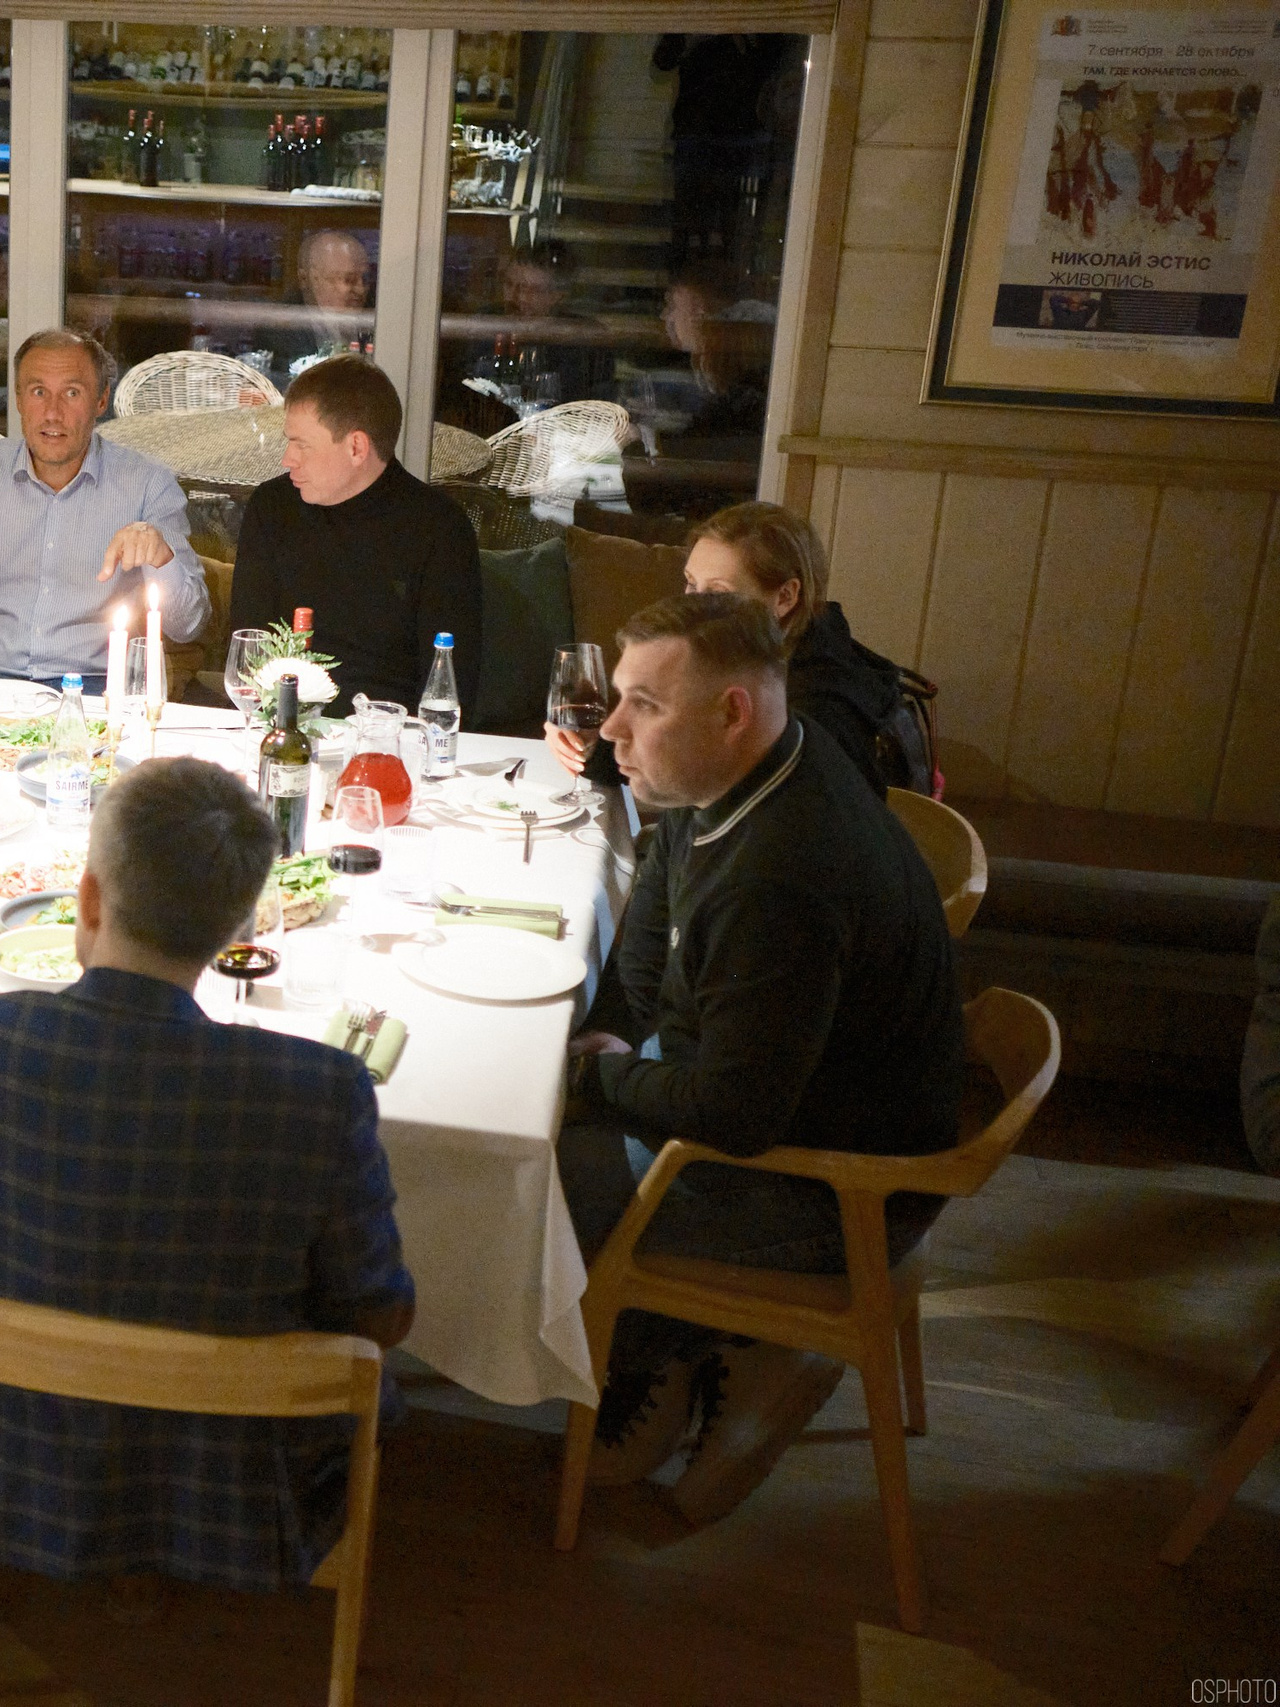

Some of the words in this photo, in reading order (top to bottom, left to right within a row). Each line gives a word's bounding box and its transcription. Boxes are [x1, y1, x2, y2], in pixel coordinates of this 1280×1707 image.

[1088, 44, 1097, 55] 7
[1099, 44, 1164, 58] сентября
[1176, 44, 1194, 57] 28
[1197, 45, 1256, 59] октября
[1109, 66, 1130, 77] ГДЕ
[1132, 66, 1197, 77] КОНЧАЕТСЯ
[1051, 250, 1141, 267] НИКОЛАЙ
[1147, 254, 1211, 271] ЭСТИС
[1048, 271, 1154, 289] ЖИВОПИСЬ
[55, 779, 89, 791] SAIRME
